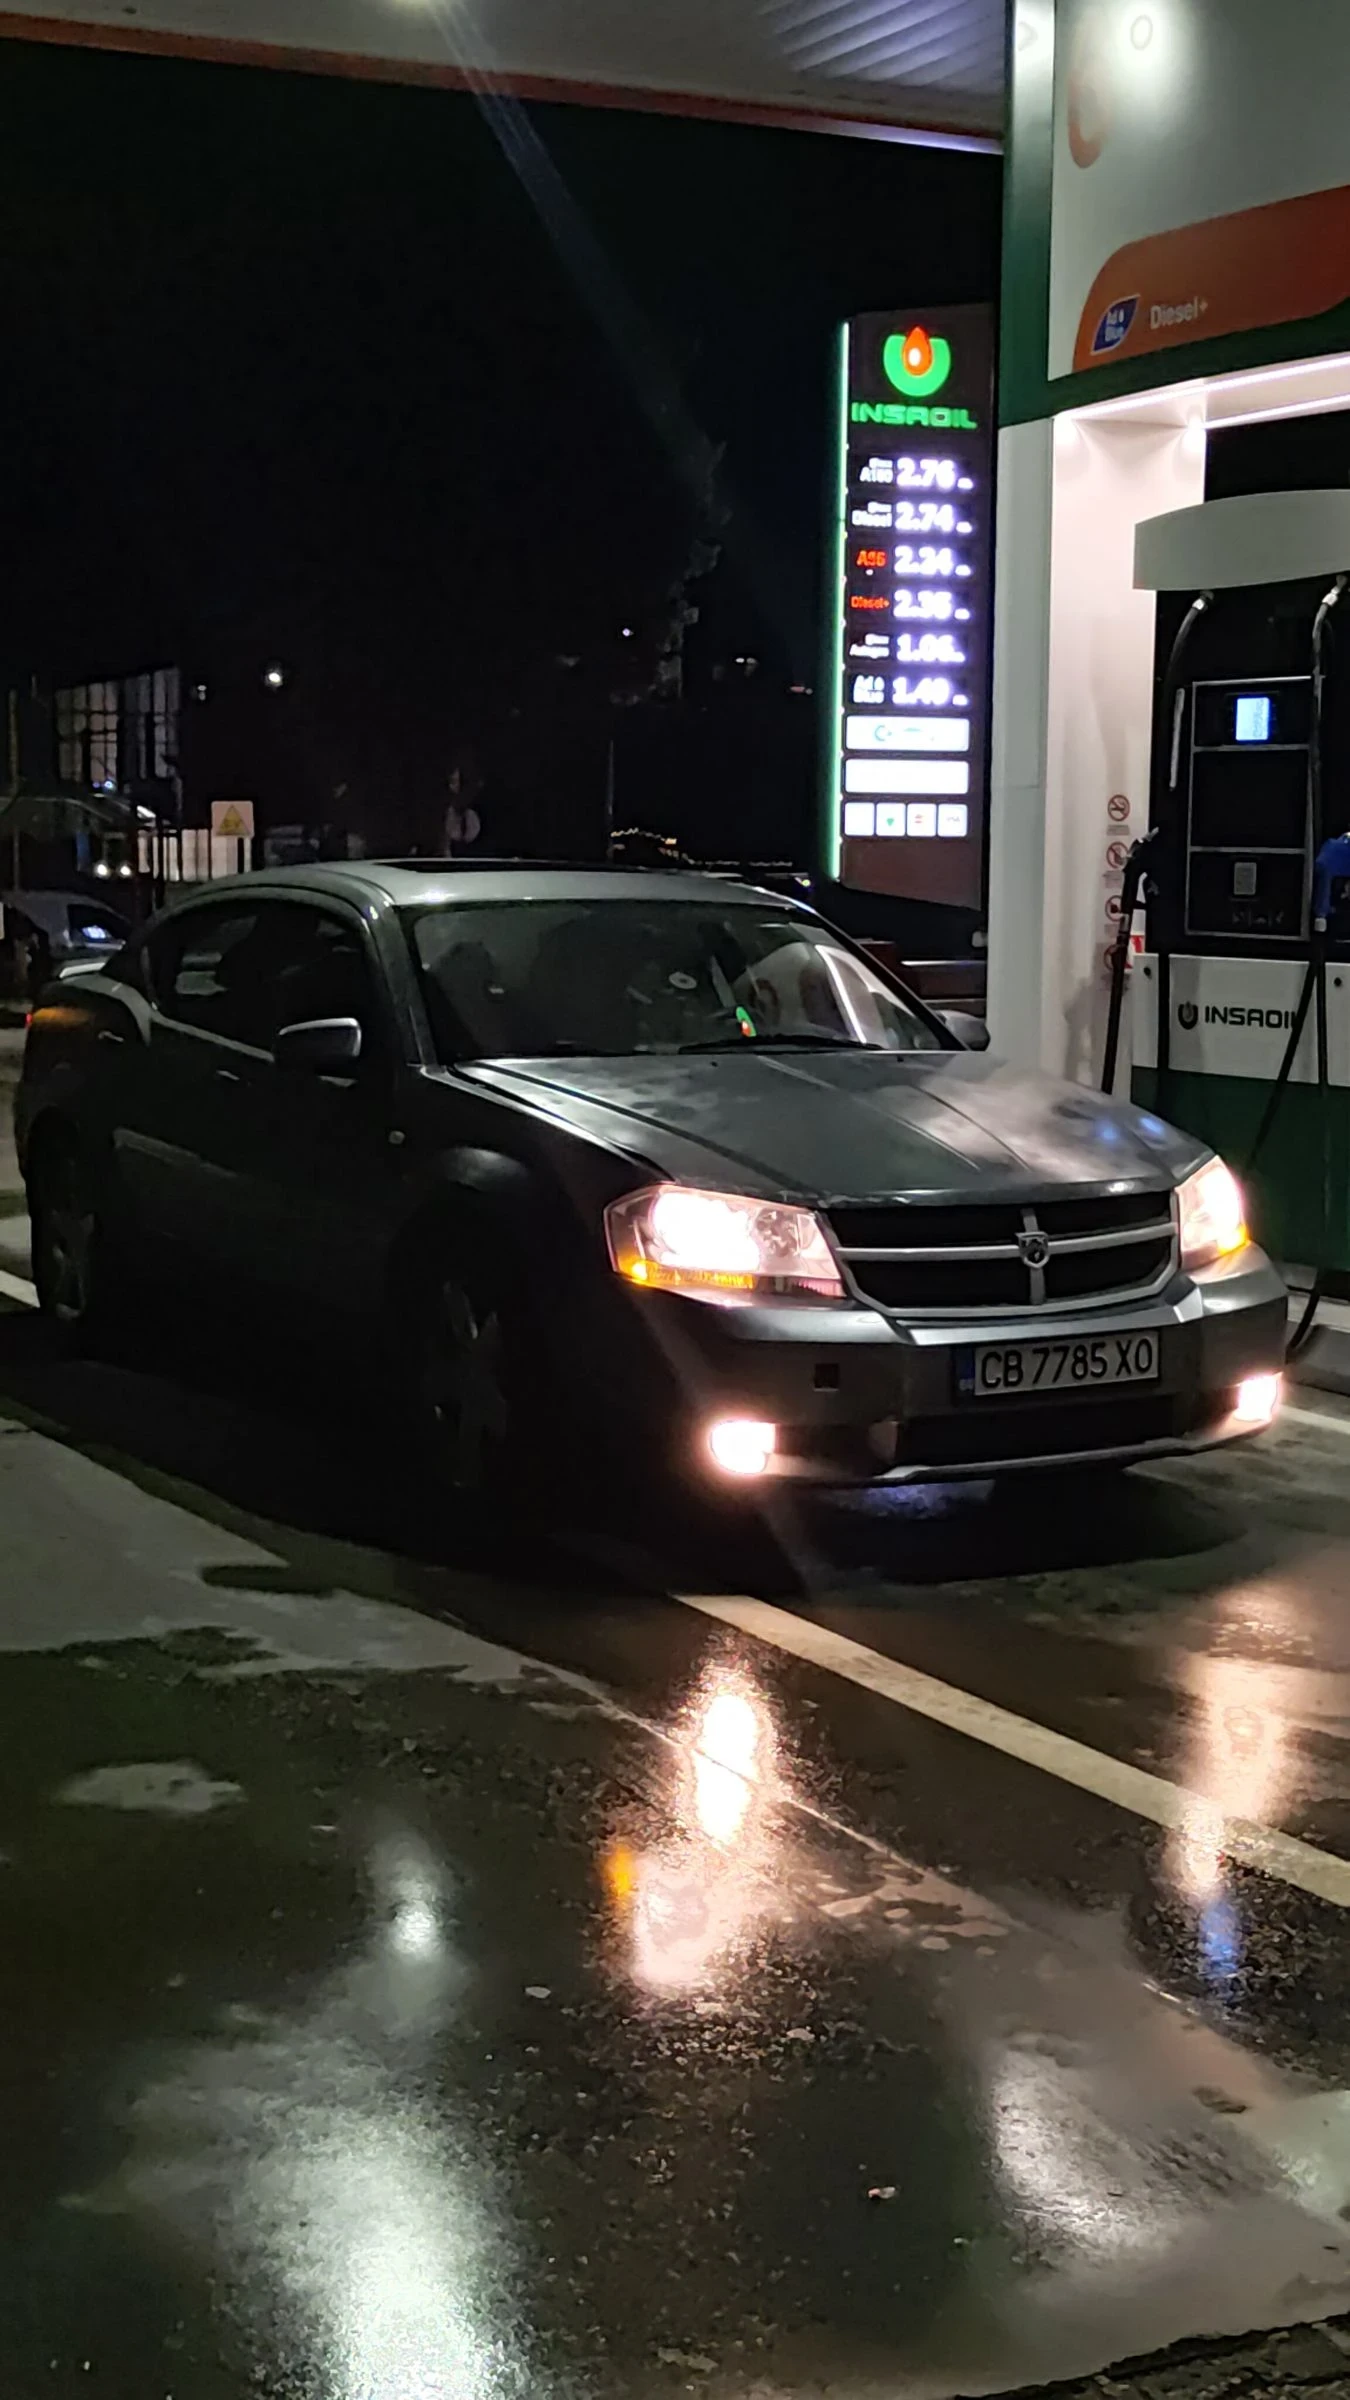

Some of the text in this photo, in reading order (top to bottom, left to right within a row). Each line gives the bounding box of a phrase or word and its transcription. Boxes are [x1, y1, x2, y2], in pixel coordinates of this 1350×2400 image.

[1150, 296, 1208, 331] Diesel+
[895, 501, 955, 533] 2.74
[981, 1335, 1153, 1389] CB 7785 XO
